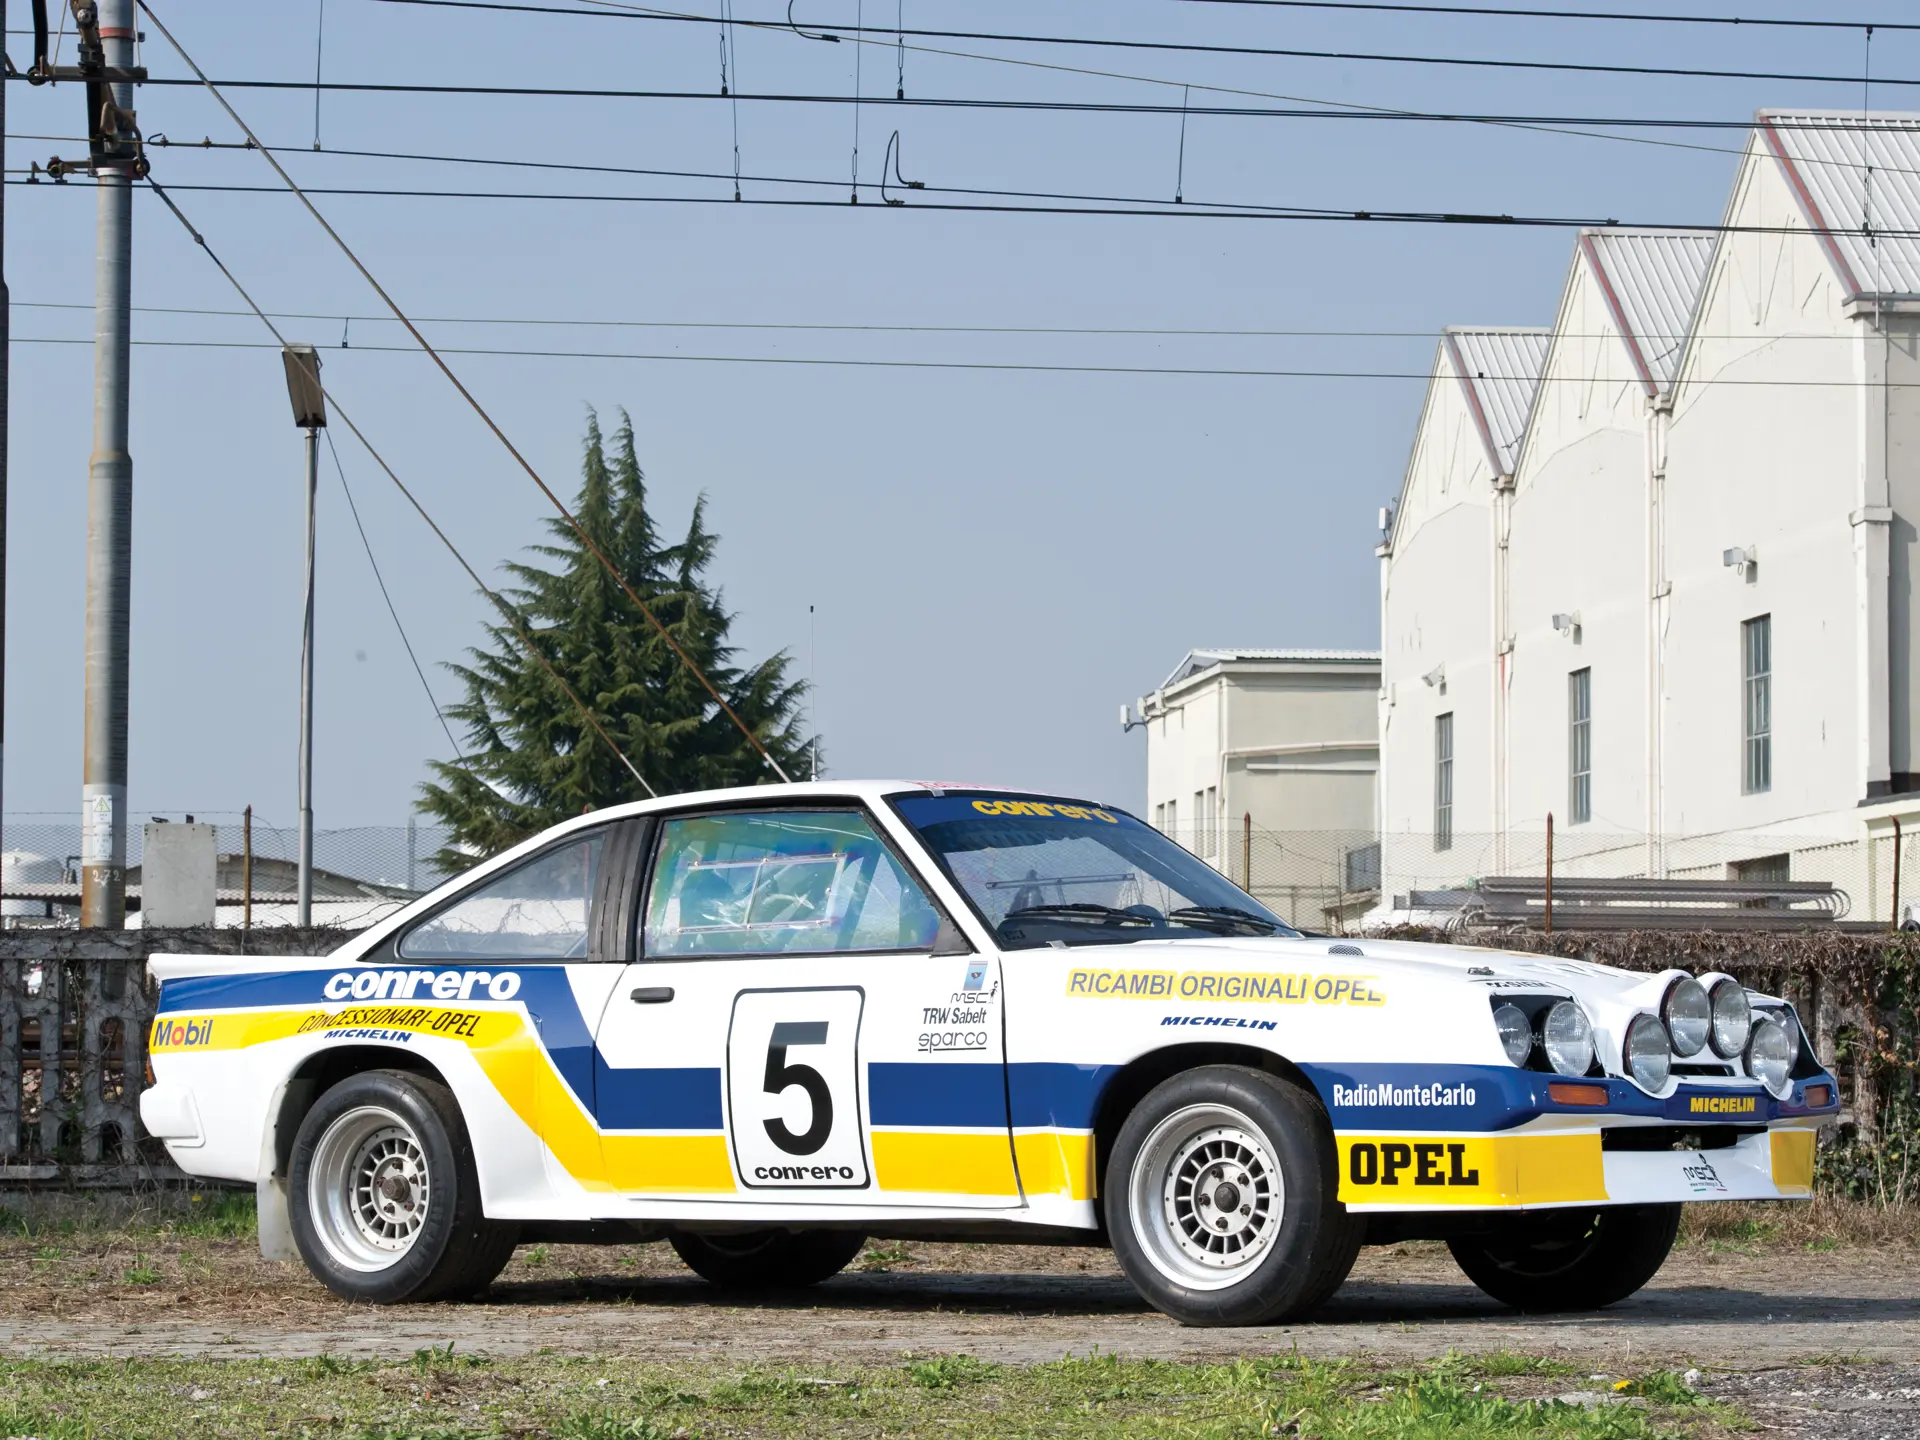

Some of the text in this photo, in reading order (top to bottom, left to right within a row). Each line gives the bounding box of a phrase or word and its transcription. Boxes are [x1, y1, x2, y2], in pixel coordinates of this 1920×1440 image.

[971, 801, 1118, 823] conrero
[323, 970, 521, 1000] conrero
[1070, 972, 1381, 1001] RICAMBI ORIGINALI OPEL
[297, 1008, 481, 1037] CONCESSIONARI-OPEL
[923, 1007, 987, 1024] TRW Sabelt
[1160, 1016, 1278, 1031] MICHELIN
[153, 1019, 214, 1047] Mobil
[324, 1029, 412, 1043] MICHELIN
[918, 1031, 988, 1053] sparco
[762, 1021, 833, 1156] 5
[1333, 1083, 1476, 1106] RadioMonteCarlo
[1690, 1097, 1756, 1113] MICHELIN
[754, 1166, 854, 1180] conrero
[1350, 1143, 1479, 1186] OPEL
